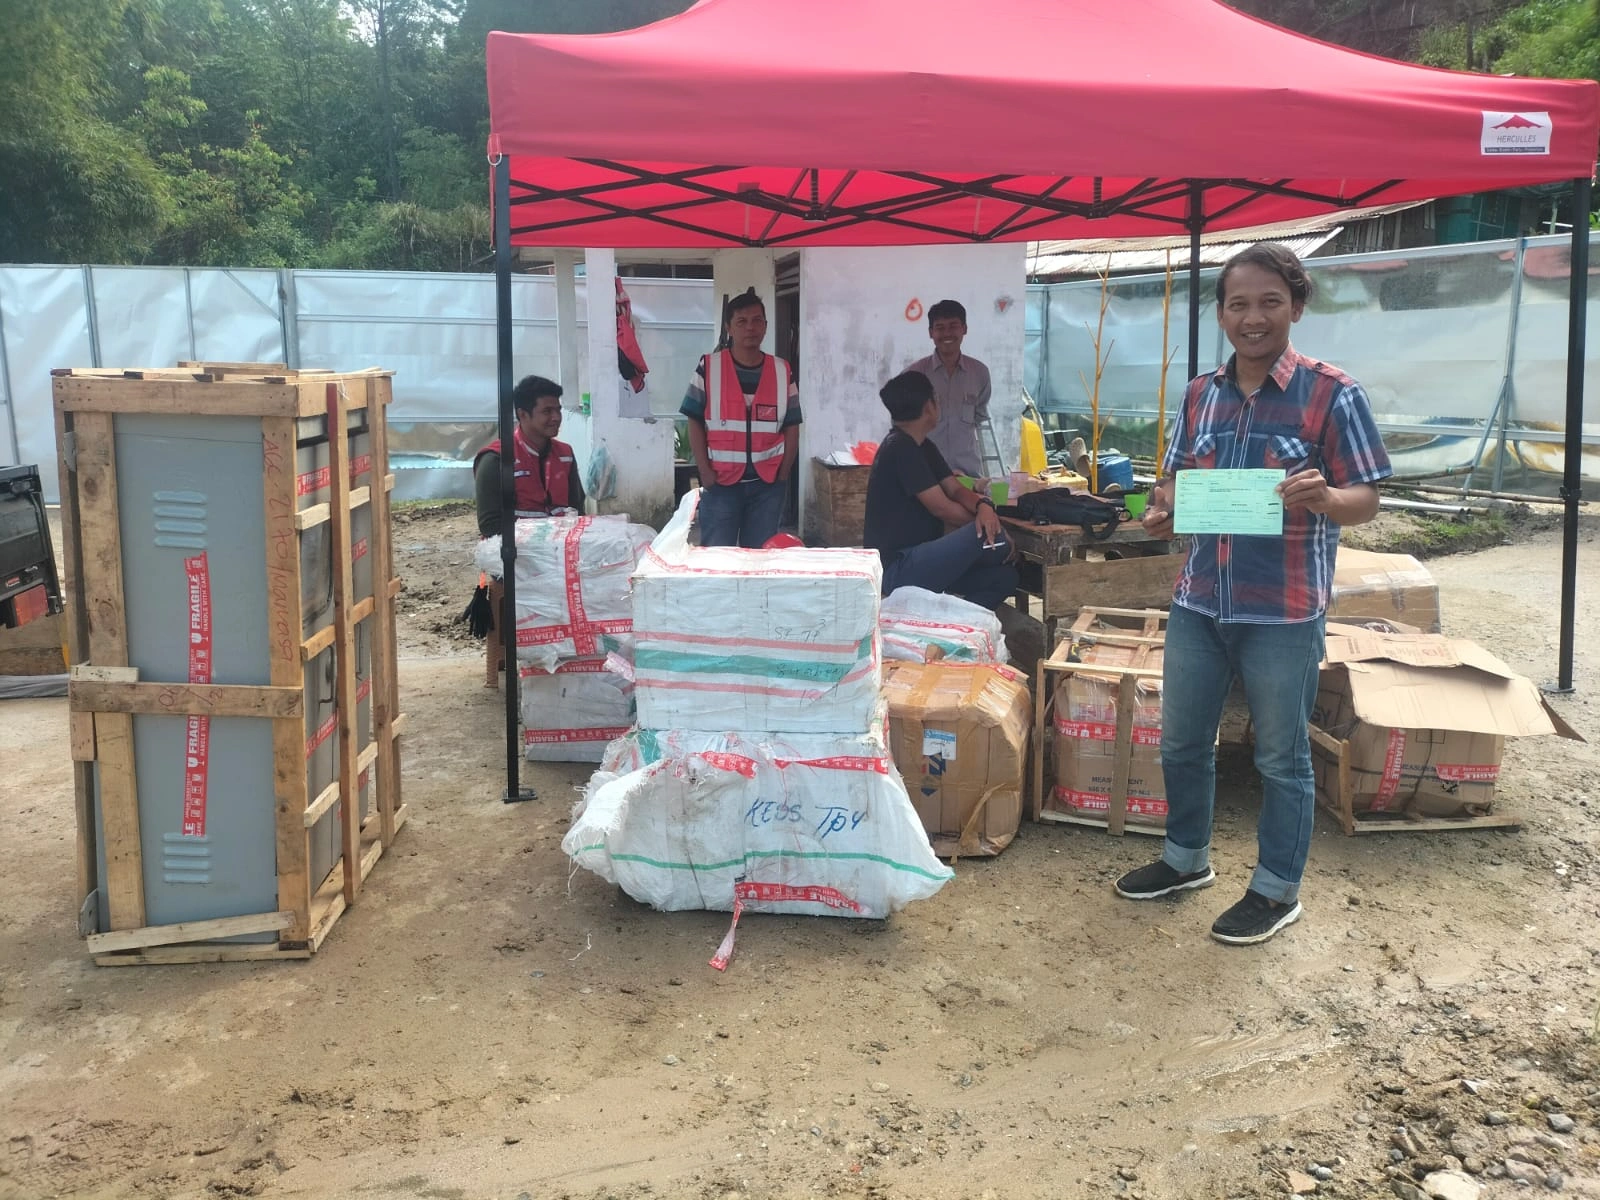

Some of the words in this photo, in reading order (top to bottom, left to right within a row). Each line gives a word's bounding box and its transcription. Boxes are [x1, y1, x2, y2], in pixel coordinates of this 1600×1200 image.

[1496, 135, 1537, 143] HERCULLES
[190, 573, 200, 630] FRAGILE
[188, 716, 199, 754] FRAGI
[1391, 736, 1406, 780] FRAGILE
